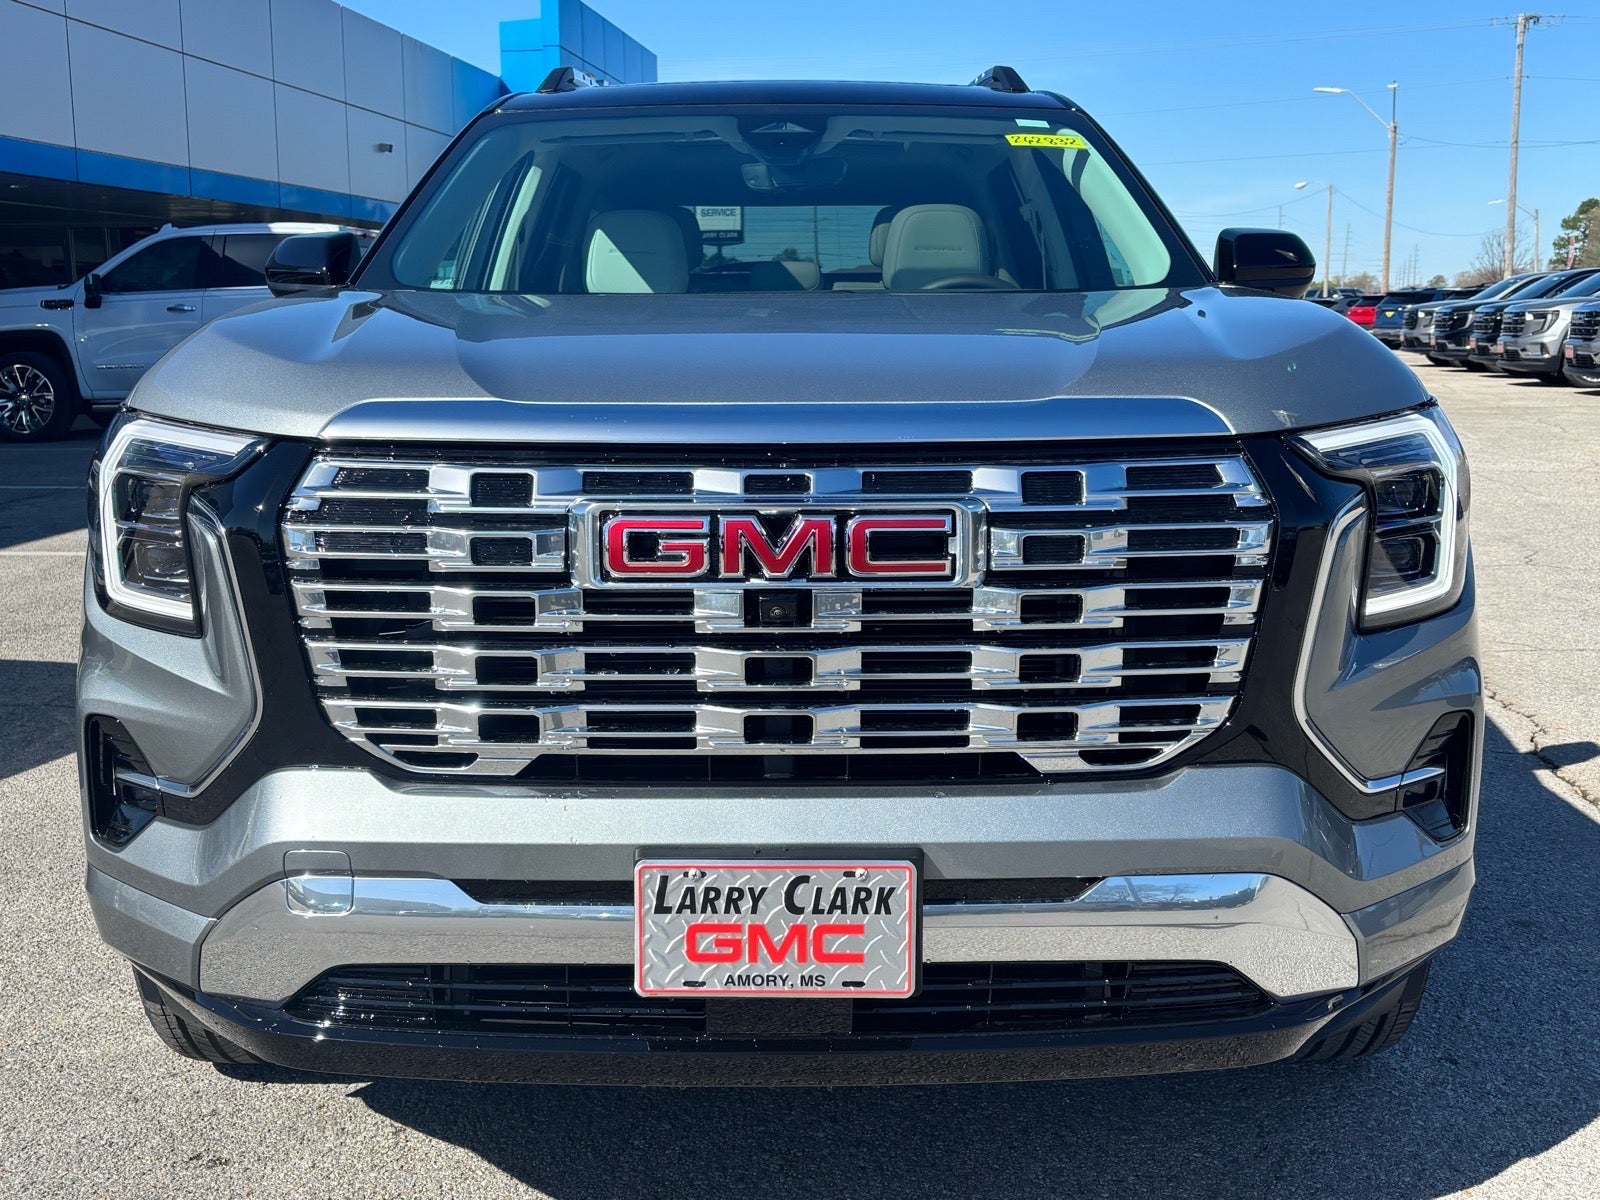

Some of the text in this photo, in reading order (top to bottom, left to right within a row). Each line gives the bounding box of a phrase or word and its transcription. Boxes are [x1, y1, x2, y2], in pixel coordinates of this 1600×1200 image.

[701, 208, 736, 217] SERVICE
[603, 514, 952, 579] GMC
[653, 875, 896, 915] LARRY CLARK
[685, 922, 865, 964] GMC
[724, 974, 826, 989] AMORY, MS
